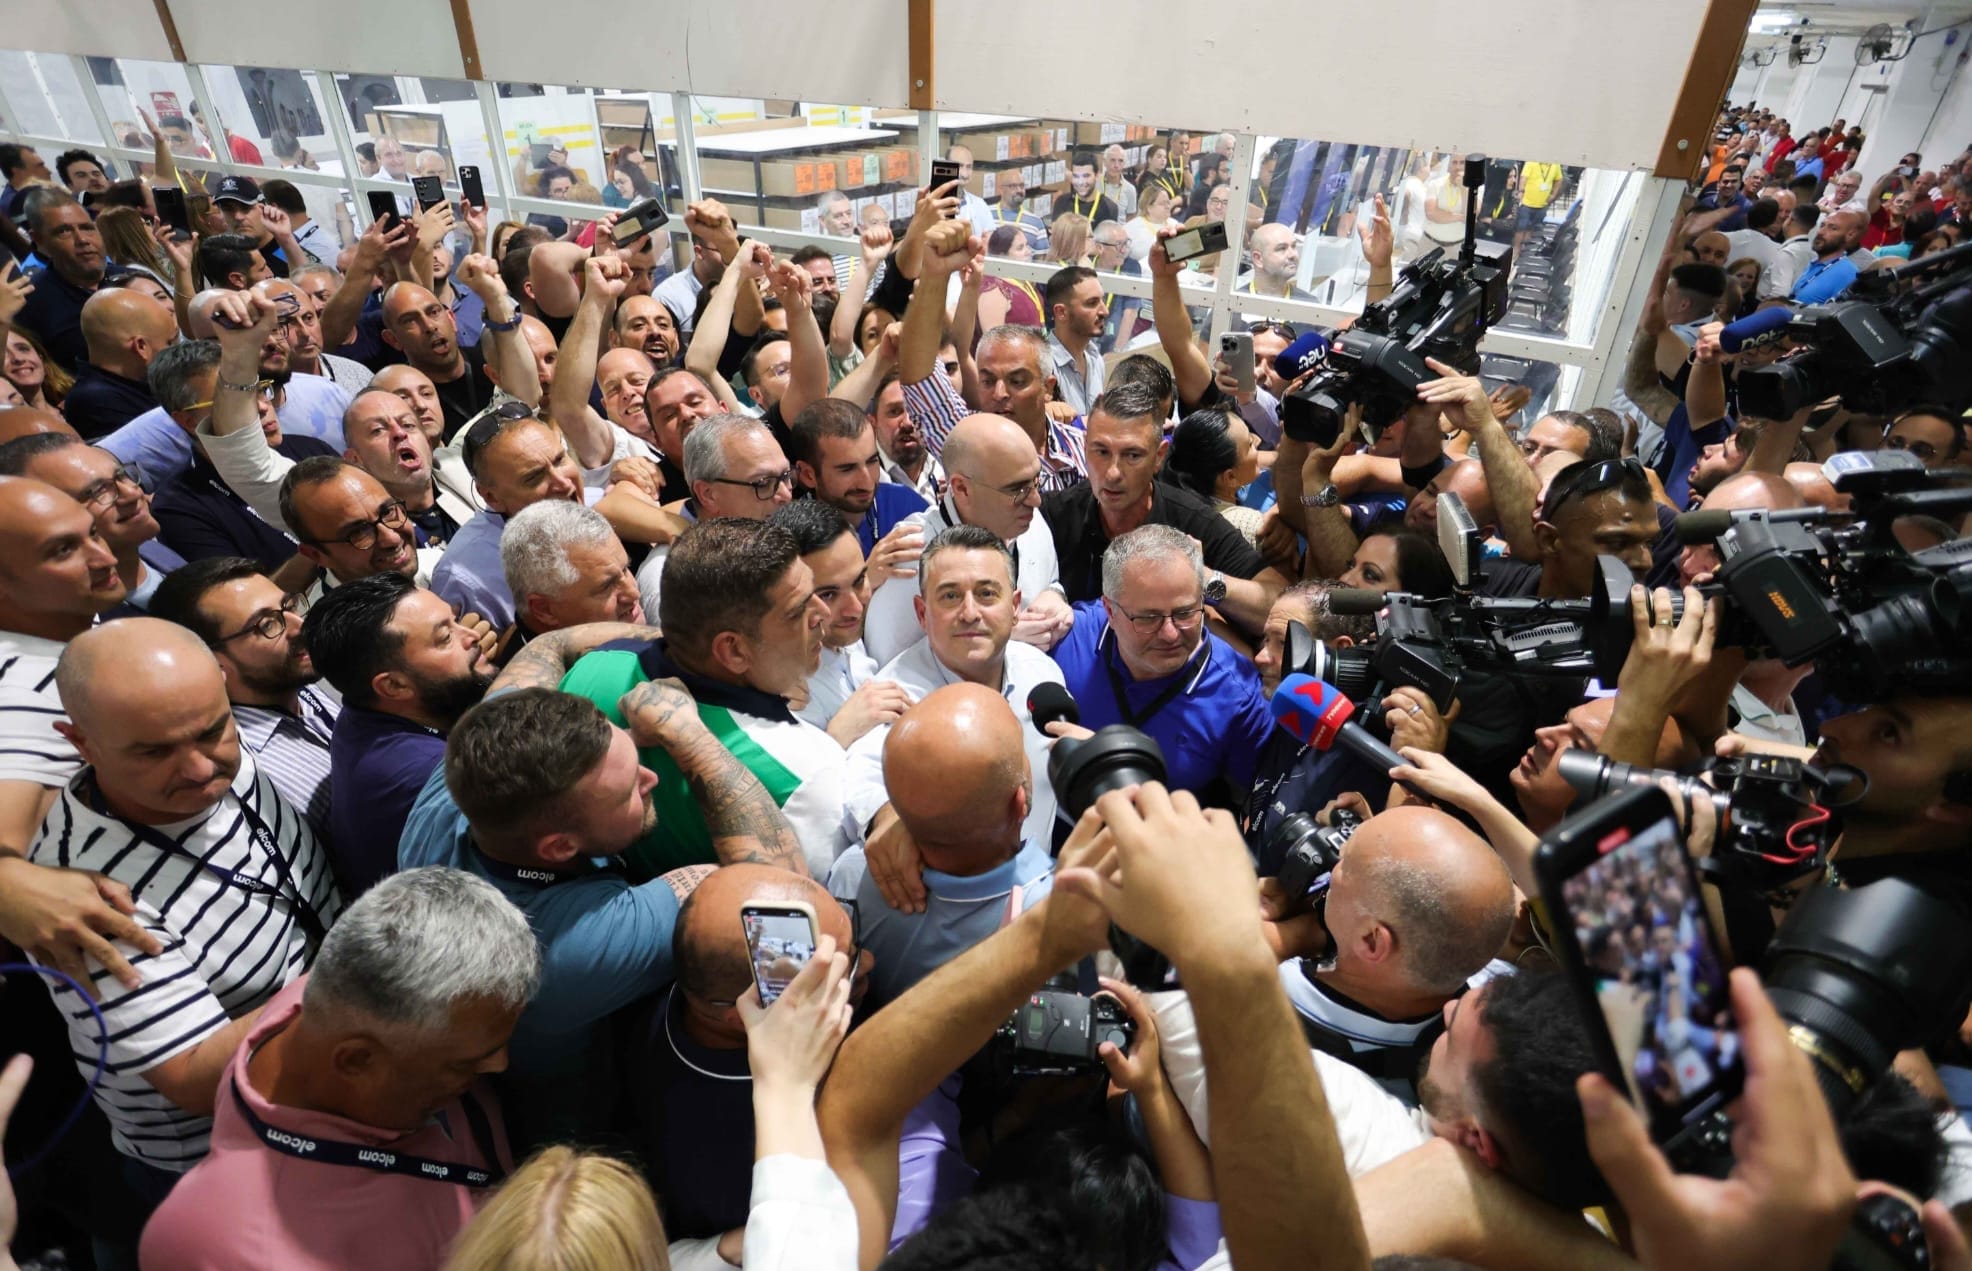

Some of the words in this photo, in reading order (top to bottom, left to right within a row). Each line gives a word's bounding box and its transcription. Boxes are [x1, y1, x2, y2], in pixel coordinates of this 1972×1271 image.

[1741, 329, 1777, 352] net
[1298, 344, 1326, 370] net
[209, 479, 231, 497] elcom
[299, 690, 322, 713] elcom
[1252, 810, 1264, 832] elcom
[256, 827, 277, 857] elcom
[232, 873, 264, 890] elcom
[517, 868, 556, 884] elcom
[266, 1128, 317, 1154] elcom
[358, 1149, 396, 1167] elcom
[421, 1162, 449, 1179] elcom
